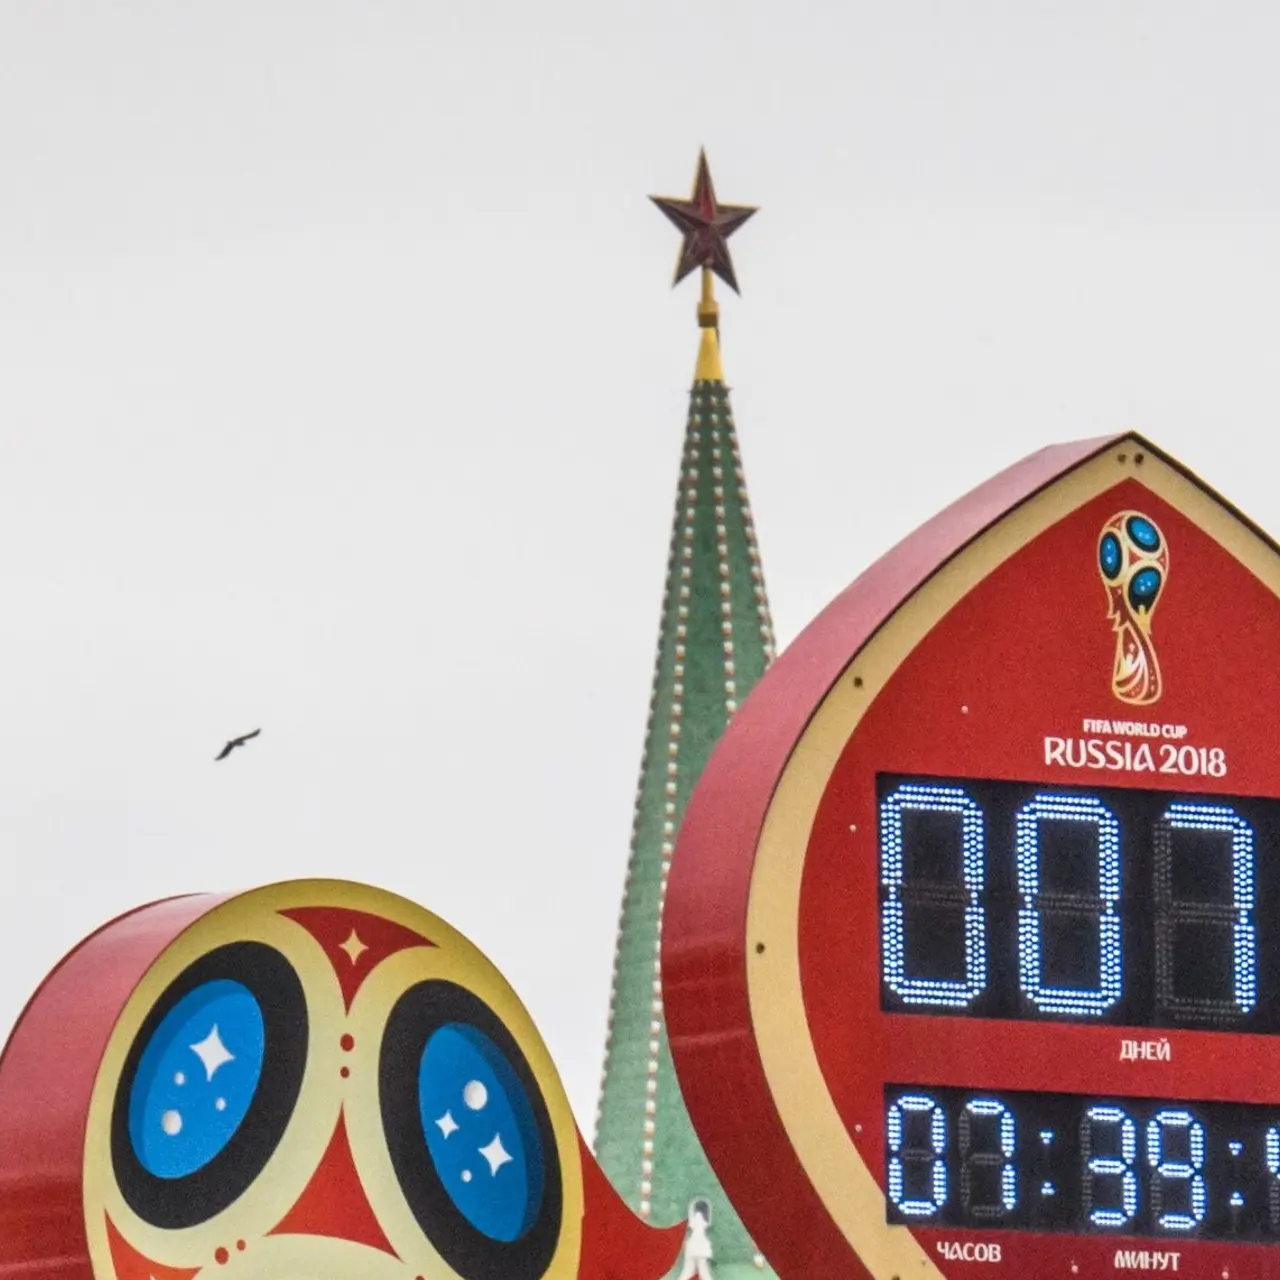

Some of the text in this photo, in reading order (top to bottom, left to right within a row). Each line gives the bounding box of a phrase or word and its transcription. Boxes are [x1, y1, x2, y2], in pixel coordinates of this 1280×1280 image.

[1082, 718, 1188, 739] FIFA WORLD CUP
[1044, 736, 1228, 778] RUSSIA 2018
[1120, 1037, 1172, 1062] ДНЕЙ
[936, 1240, 1002, 1263] ЧАСОВ
[1114, 1249, 1181, 1272] МИНУТ
